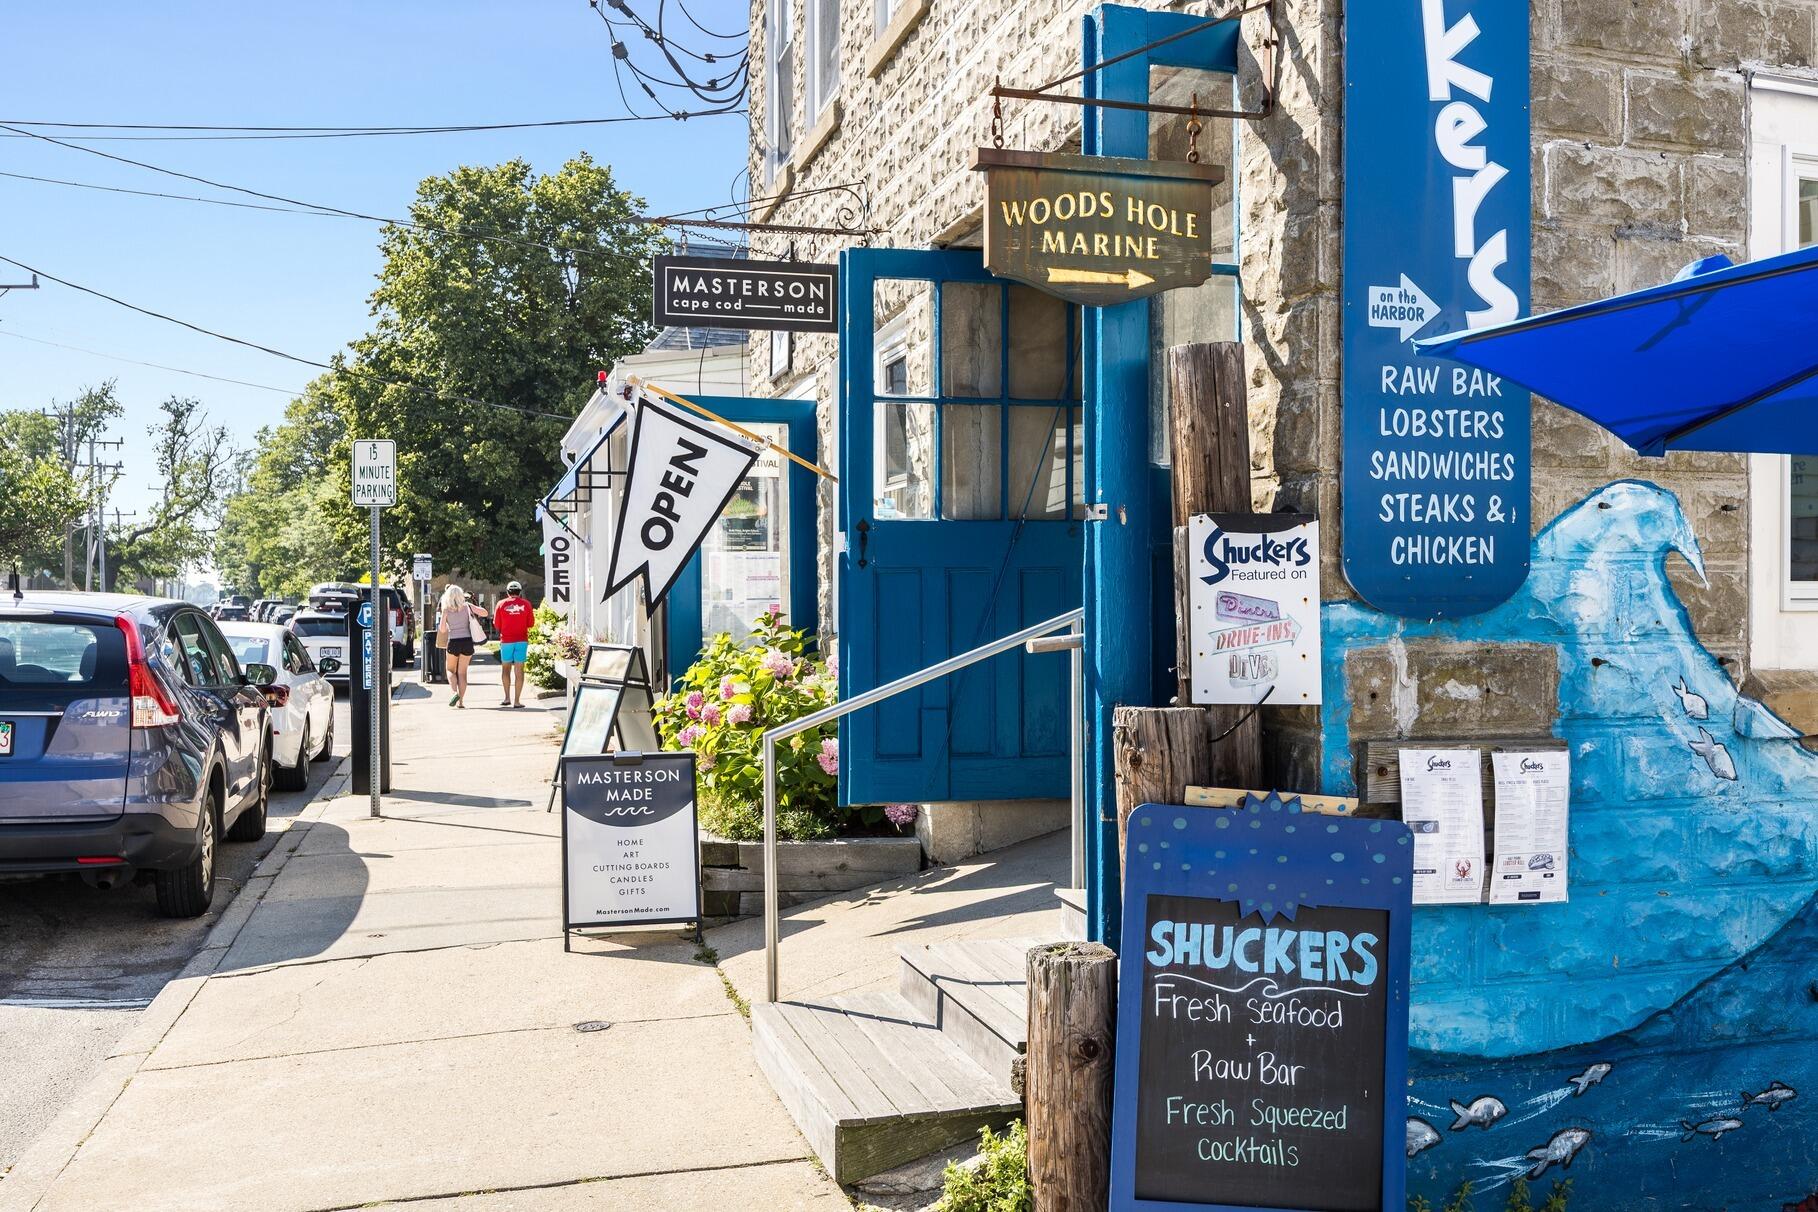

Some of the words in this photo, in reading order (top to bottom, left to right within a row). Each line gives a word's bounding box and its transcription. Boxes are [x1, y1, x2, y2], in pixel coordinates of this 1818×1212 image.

[1001, 191, 1114, 227] WOODS
[1127, 197, 1198, 238] HOLE
[1042, 230, 1160, 259] MARINE
[673, 275, 824, 300] MASTERSON
[1380, 293, 1393, 303] on
[1399, 288, 1417, 304] the
[673, 298, 709, 311] cape
[715, 298, 742, 310] cod
[784, 302, 824, 314] made
[1371, 304, 1425, 322] HARBOR
[1381, 365, 1440, 396] RAW
[1380, 407, 1505, 439] LOBSTERS
[369, 446, 378, 461] 15
[1369, 450, 1515, 481] SANDWICHES
[359, 465, 390, 479] MINUTE
[356, 484, 393, 498] PARKING
[640, 436, 709, 551] OPEN
[1379, 493, 1475, 523] STEAKS
[1486, 494, 1505, 523] &
[1200, 527, 1311, 586] Shuckers
[1390, 535, 1494, 565] CHICKEN
[550, 536, 570, 603] OPEN
[1231, 569, 1286, 581] Featured
[1291, 569, 1307, 579] on
[364, 631, 372, 655] PAY
[364, 657, 372, 687] HERE
[82, 710, 121, 718] AWD
[577, 769, 681, 785] MASTERSON
[606, 788, 653, 802] MADE
[592, 863, 632, 872] CUTTING
[634, 862, 670, 870] BOARDS
[609, 875, 654, 884] CANDLES
[618, 888, 646, 896] GIFTS
[596, 906, 670, 915] MastersonMade.com
[1146, 920, 1379, 986] SHUCKERS
[1155, 983, 1231, 1023] Fresh
[1191, 1050, 1251, 1082] Raw
[1257, 1051, 1305, 1086] Bar
[1166, 1096, 1235, 1126] Fresh
[1250, 1098, 1347, 1133] Squeezed
